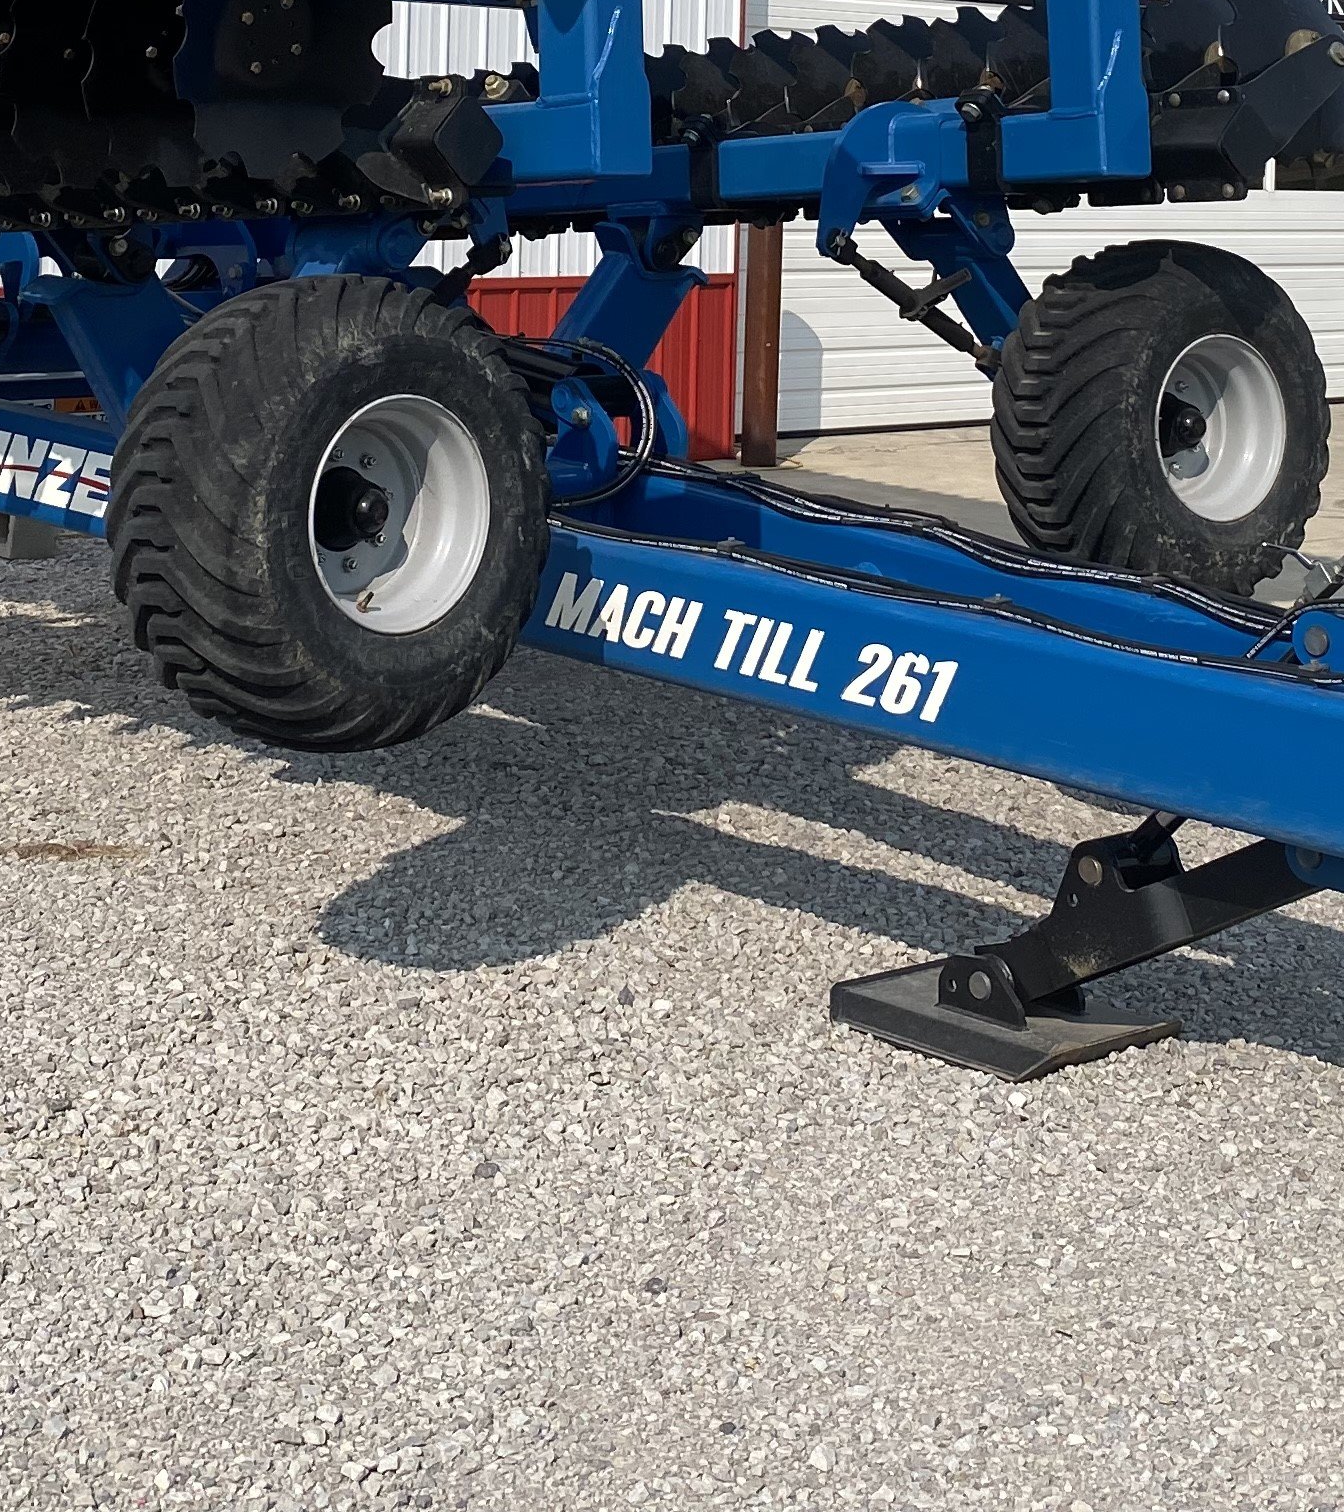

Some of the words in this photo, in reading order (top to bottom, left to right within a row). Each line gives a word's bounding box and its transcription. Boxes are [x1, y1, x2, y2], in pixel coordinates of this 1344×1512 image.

[544, 571, 703, 659] MACH
[714, 608, 824, 693] TILL
[840, 642, 960, 724] 261
